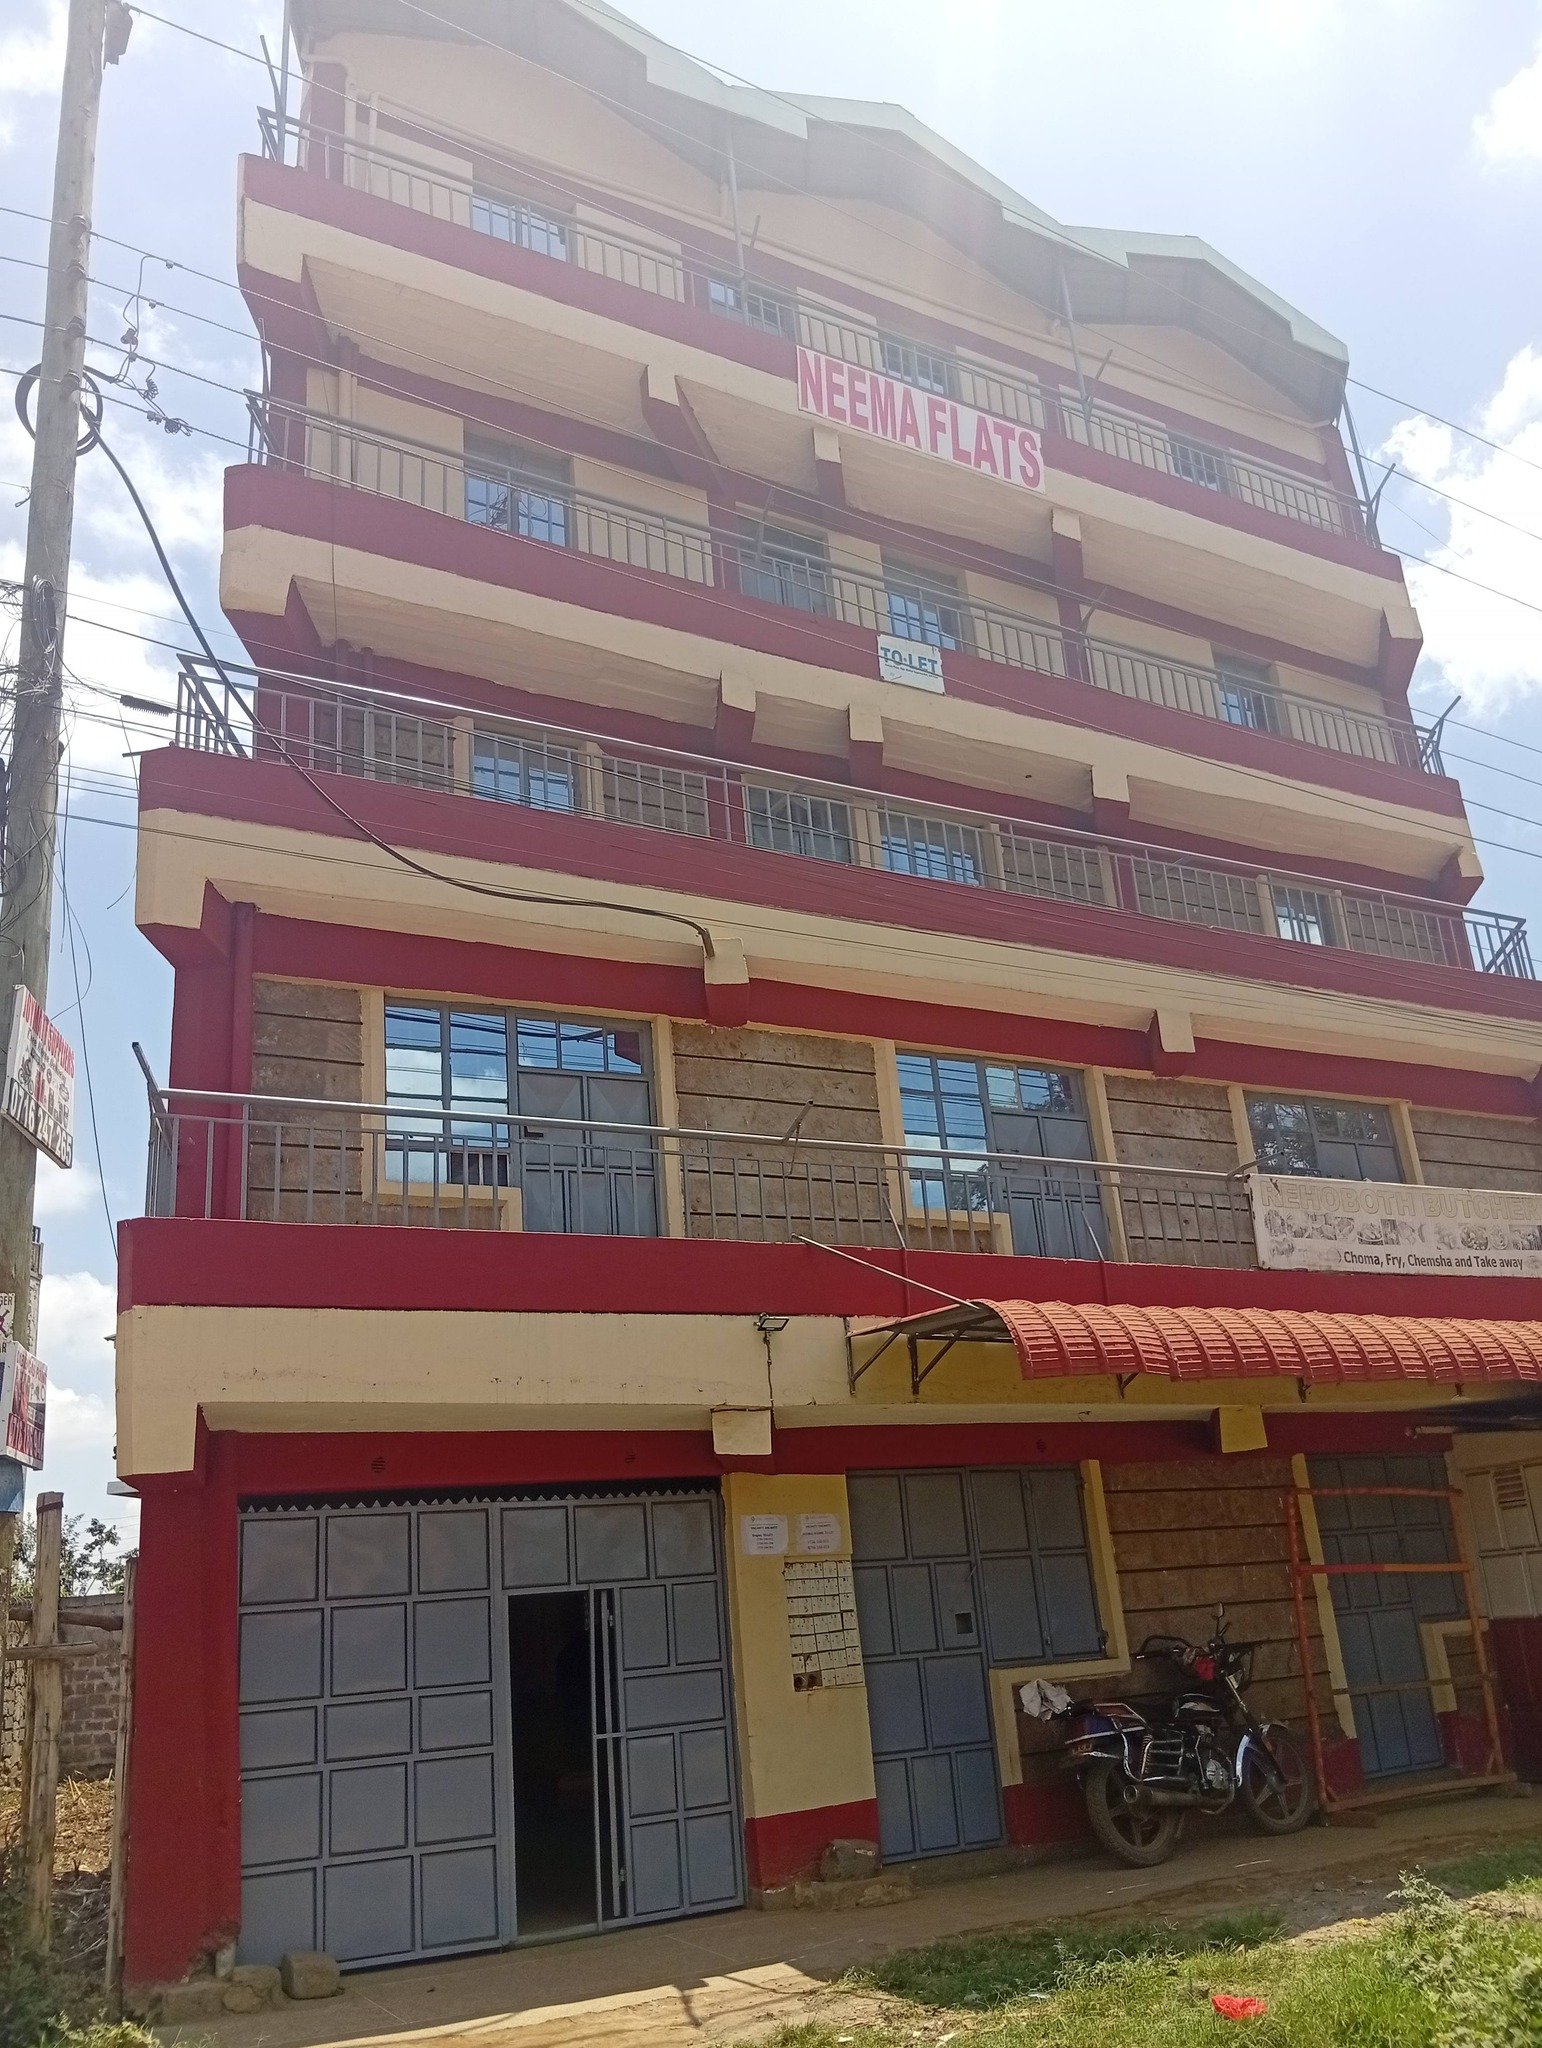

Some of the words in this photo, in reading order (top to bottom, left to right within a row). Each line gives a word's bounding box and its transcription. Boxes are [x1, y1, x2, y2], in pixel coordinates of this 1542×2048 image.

[800, 350, 921, 449] NEEMA
[926, 397, 1040, 489] FLATS
[10, 1080, 36, 1133] 0716
[36, 1107, 54, 1149] 247
[55, 1125, 72, 1167] 265
[1261, 1180, 1416, 1217] REHOBOTH
[1343, 1250, 1384, 1268] Choma,
[1386, 1253, 1406, 1269] Fry,
[1407, 1253, 1453, 1268] Chemsha
[1455, 1255, 1473, 1268] and
[1474, 1255, 1498, 1268] Take
[1500, 1258, 1523, 1270] away
